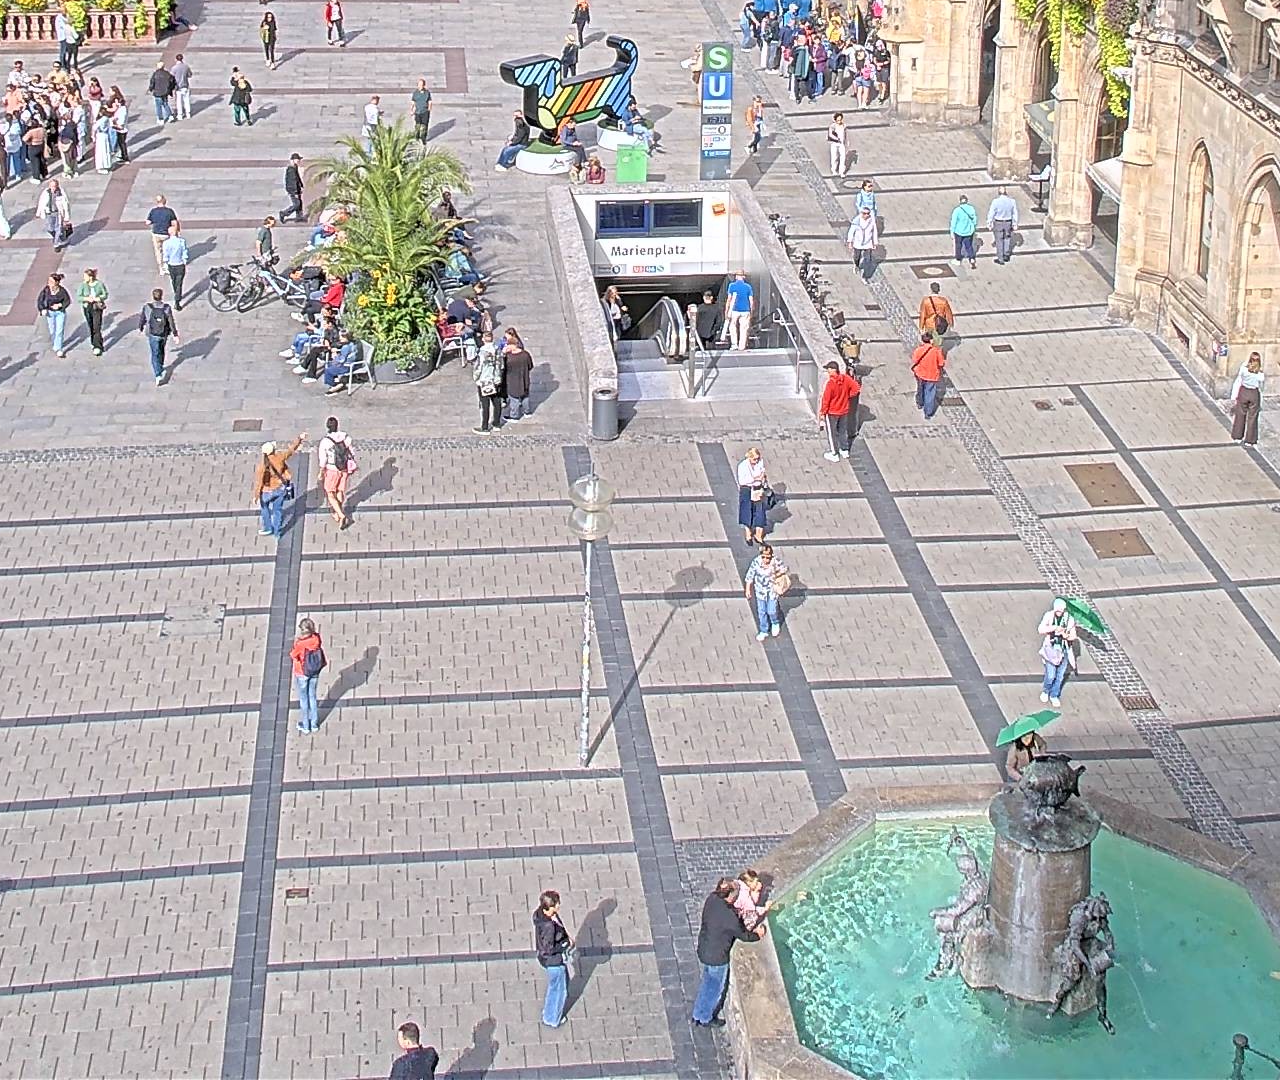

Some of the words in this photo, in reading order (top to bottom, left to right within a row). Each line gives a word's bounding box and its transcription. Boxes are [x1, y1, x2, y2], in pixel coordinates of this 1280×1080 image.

[708, 46, 729, 70] S
[708, 75, 727, 97] U
[611, 244, 687, 258] Marienplatz
